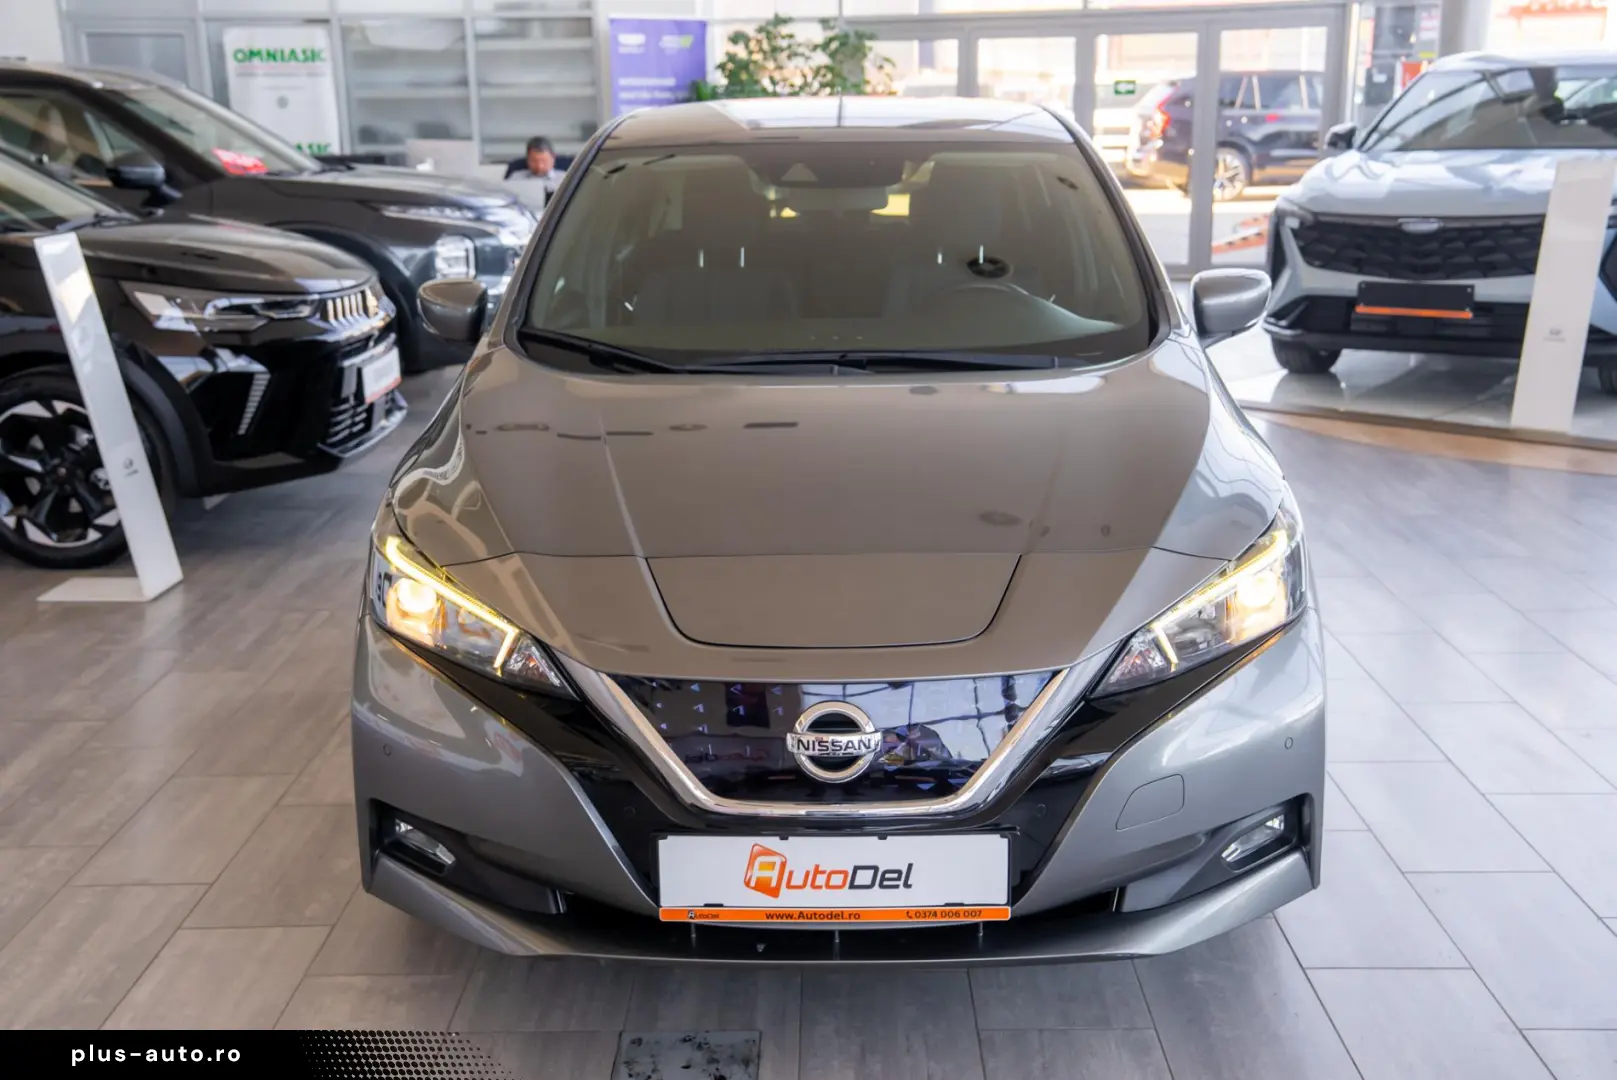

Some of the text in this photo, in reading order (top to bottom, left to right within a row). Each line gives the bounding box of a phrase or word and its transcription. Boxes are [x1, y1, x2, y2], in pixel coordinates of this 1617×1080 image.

[797, 738, 871, 752] NISSAN
[748, 849, 914, 893] AutoDel
[765, 910, 861, 920] www.Autodel.ro
[914, 909, 982, 919] 0374 006 007
